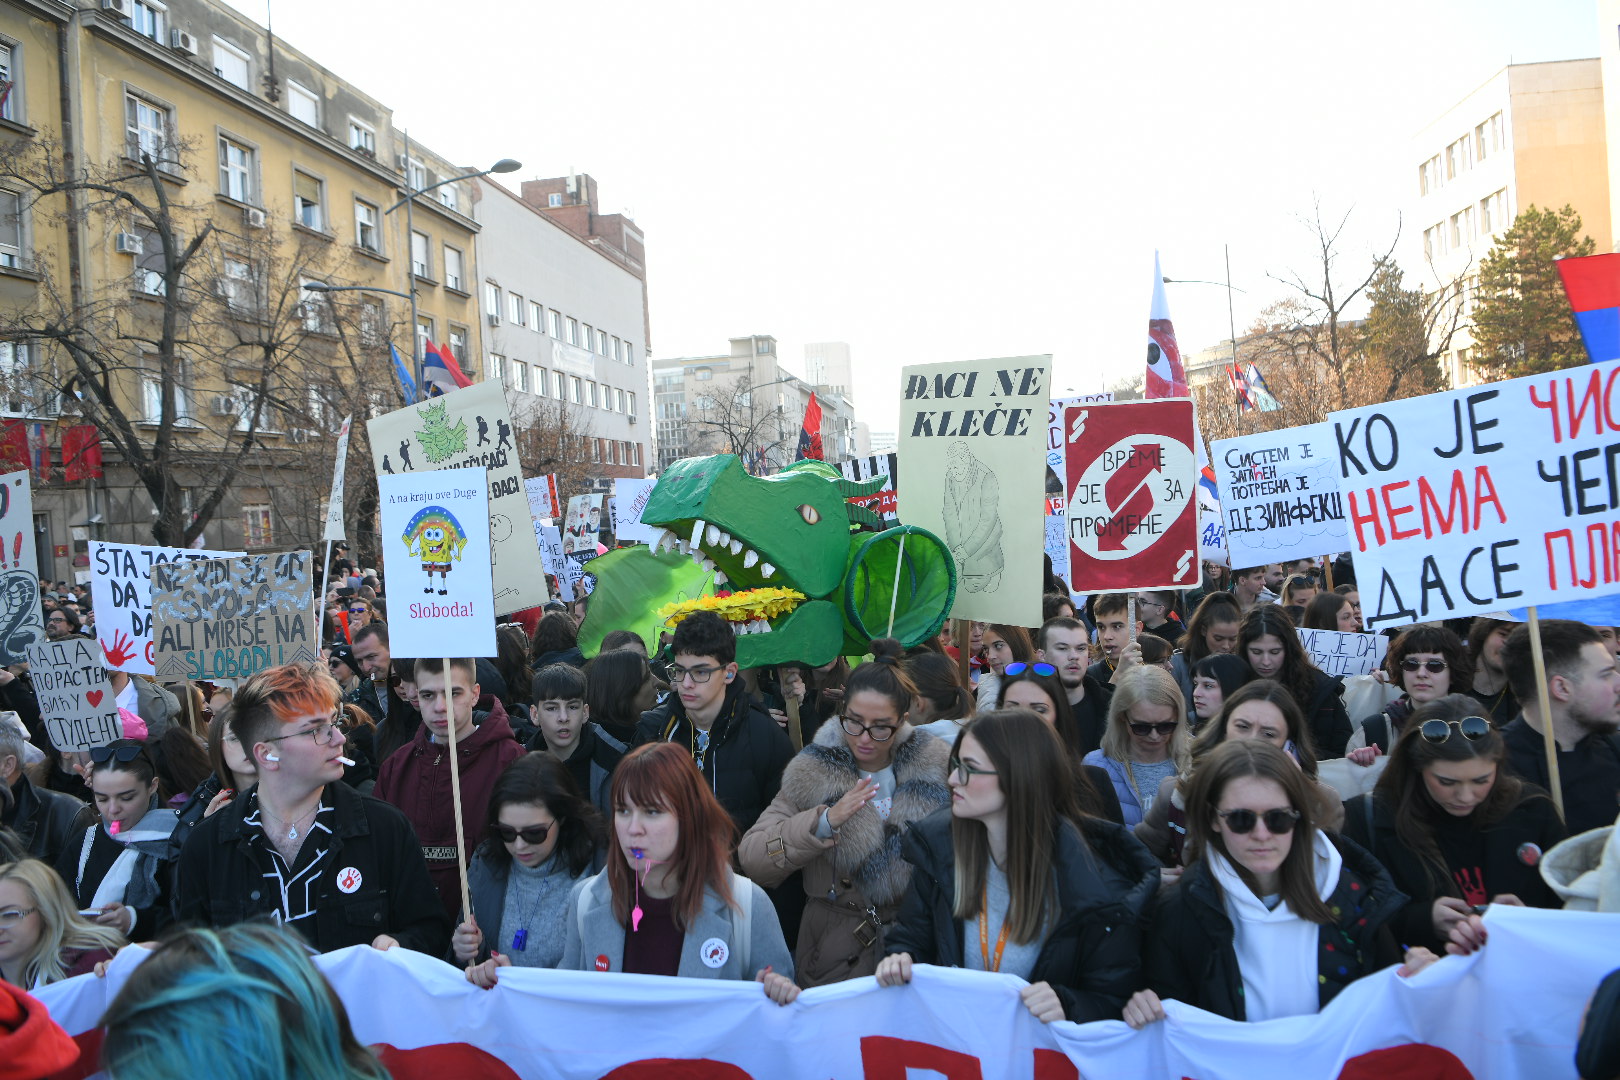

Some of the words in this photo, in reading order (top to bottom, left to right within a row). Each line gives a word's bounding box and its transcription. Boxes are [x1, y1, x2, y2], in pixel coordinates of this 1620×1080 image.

[904, 371, 979, 400] ĐACI
[990, 367, 1044, 397] NE
[911, 402, 1032, 437] KLEČE
[1334, 413, 1399, 478] КО
[1434, 389, 1504, 458] ЈЕ
[1103, 448, 1166, 471] ВРЕМЕ
[1298, 443, 1313, 459] ЈЕ
[389, 495, 396, 504] A
[397, 495, 408, 503] na
[410, 492, 433, 504] kraju
[435, 491, 451, 500] ove
[453, 488, 477, 500] Duge
[1079, 484, 1101, 505] ЈЕ
[1164, 479, 1184, 502] ЗА
[1232, 479, 1291, 501] ПОТРЕБНА
[1296, 476, 1310, 491] ЈЕ
[1347, 465, 1507, 552] НЕМА
[1070, 514, 1162, 539] ПРОМЕНЕ
[96, 543, 139, 579] ŠTA
[110, 579, 140, 608] DA
[409, 602, 474, 619] Sloboda!
[159, 622, 195, 653] ALI
[204, 616, 267, 650] MIRIŠE
[275, 614, 307, 644] NA
[1357, 635, 1377, 659] DA
[26, 641, 92, 669] КАДА
[33, 666, 111, 692] ПОРАСТЕМ
[47, 713, 120, 750] СТУДЕНТ
